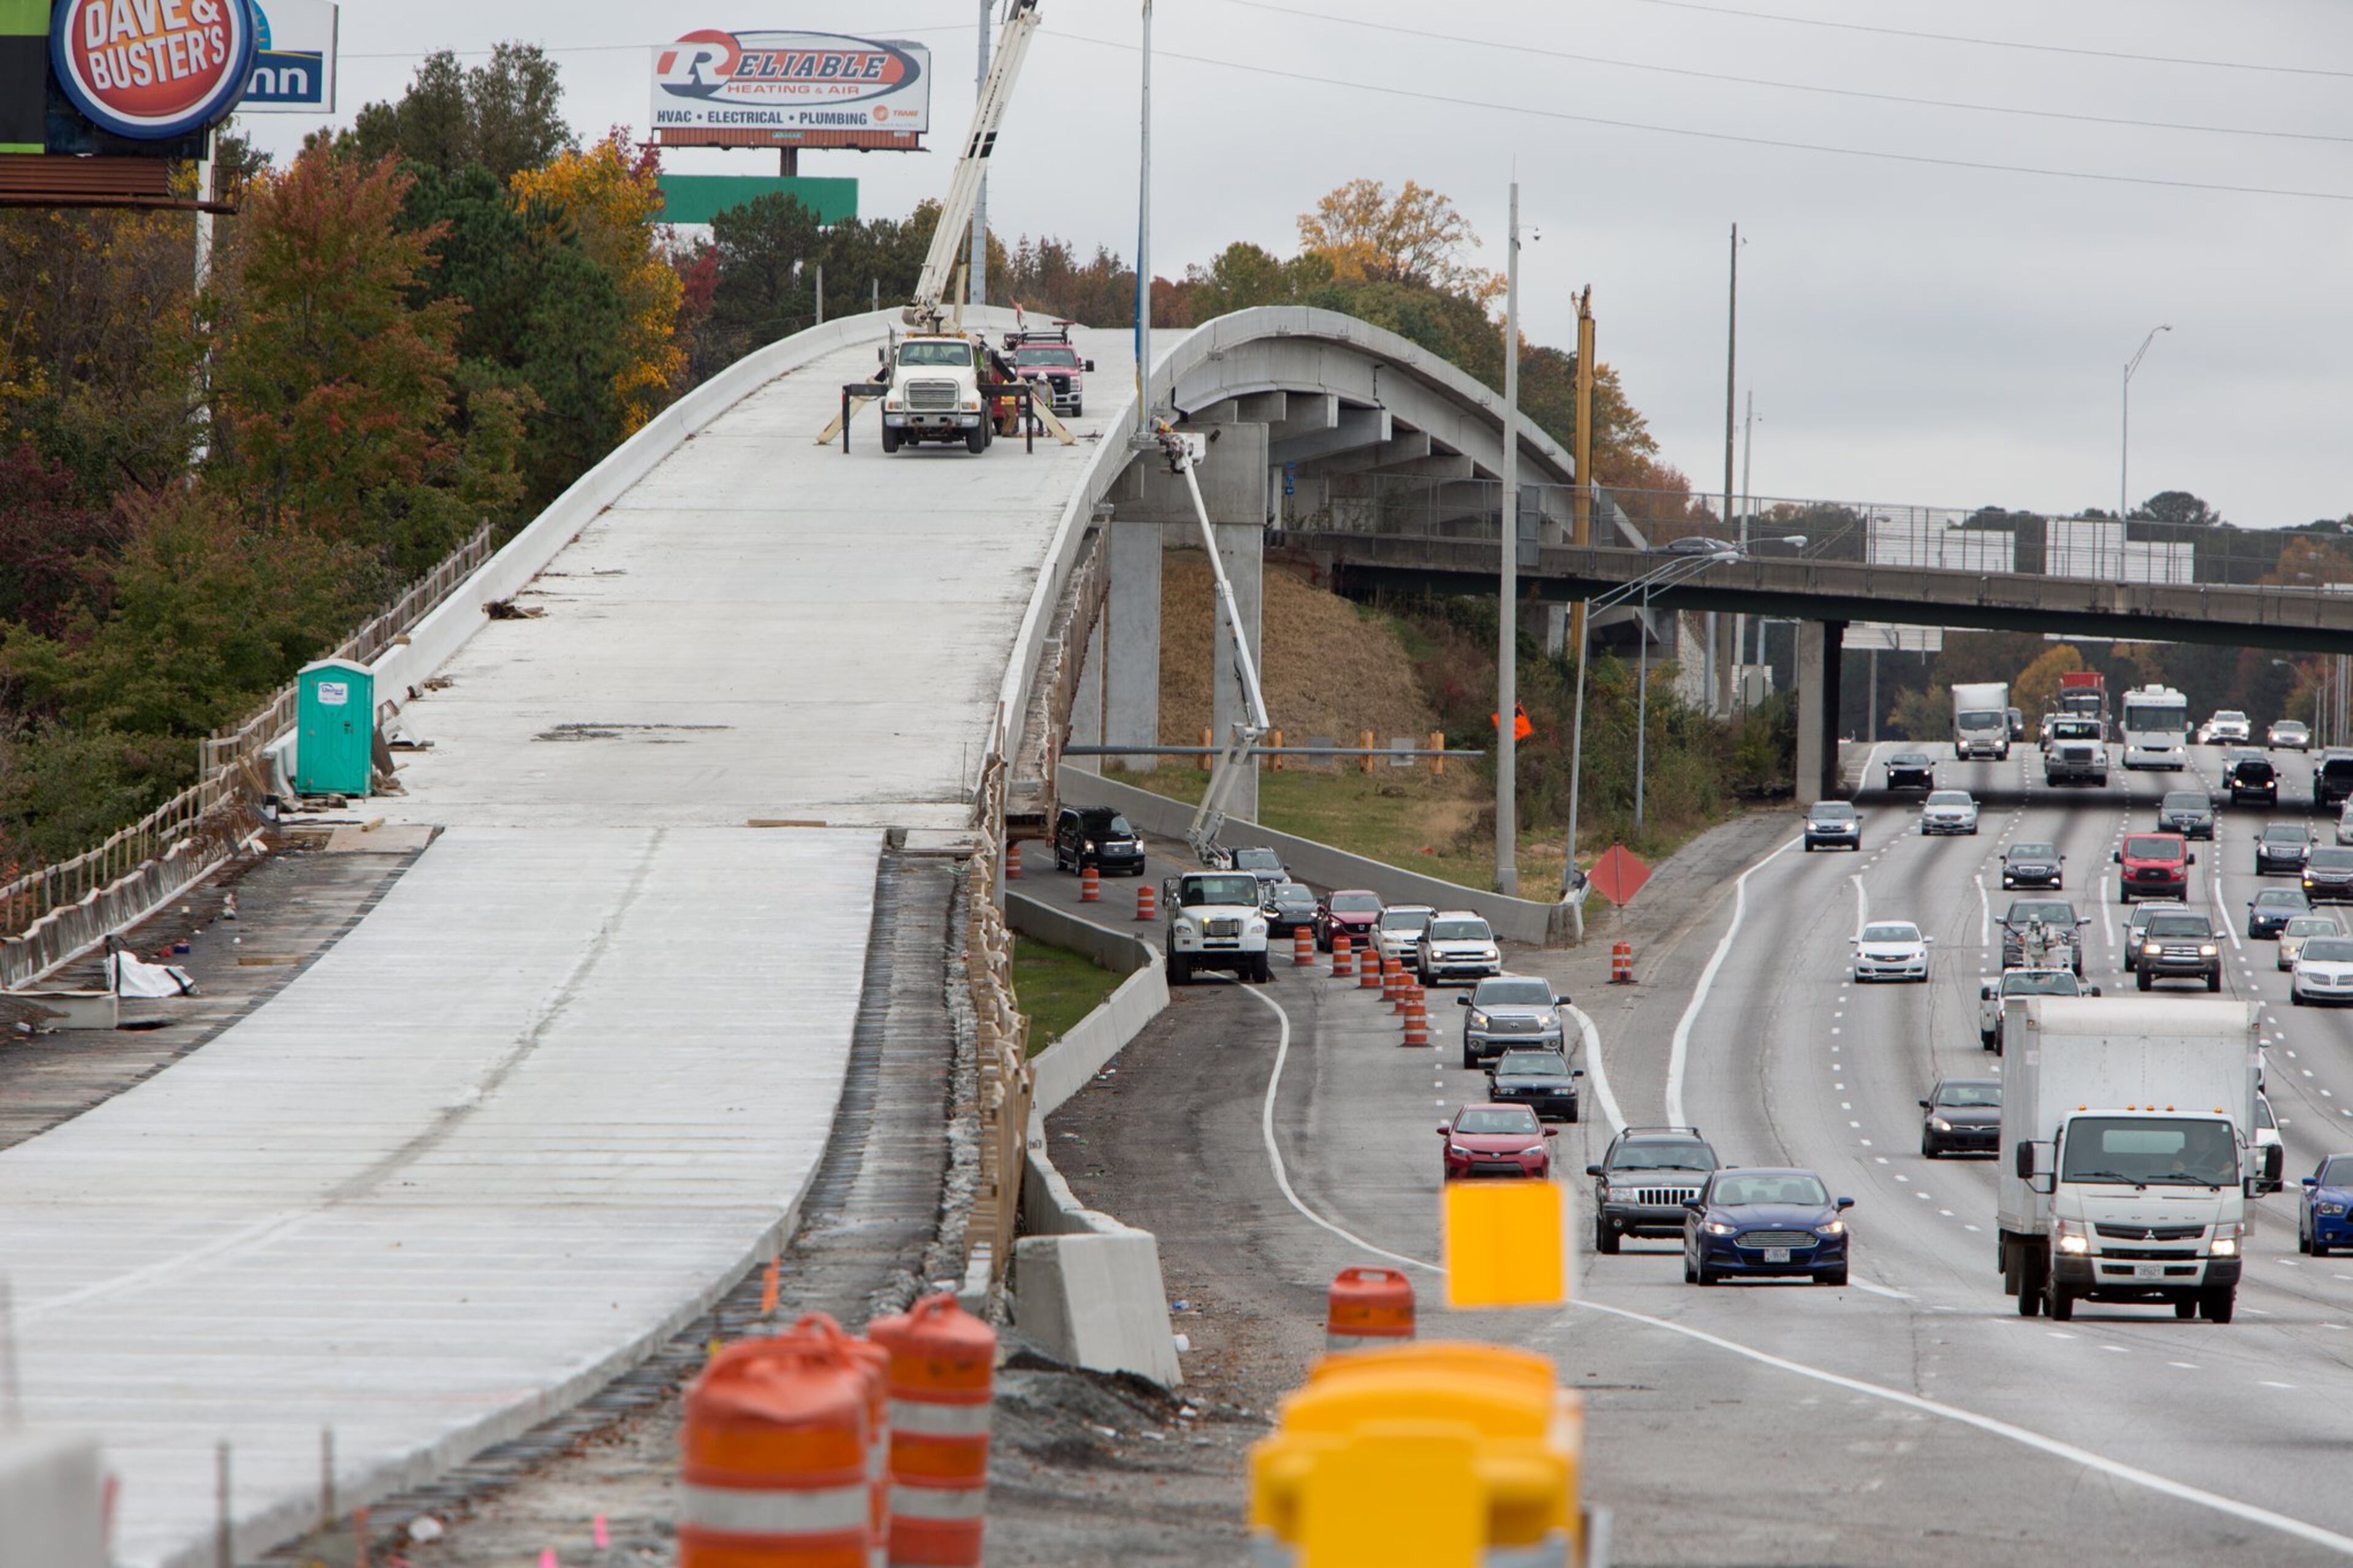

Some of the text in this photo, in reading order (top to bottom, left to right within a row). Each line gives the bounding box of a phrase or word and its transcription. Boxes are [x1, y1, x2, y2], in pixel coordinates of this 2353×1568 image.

[85, 0, 221, 49] DAVE &
[88, 25, 225, 90] BUSTER'S
[658, 37, 889, 90] RELIABLE
[246, 67, 308, 94] nn
[727, 85, 810, 94] HEATING
[828, 86, 859, 95] AIR
[657, 110, 867, 125] HVAC ELECTRICAL PLUMBING
